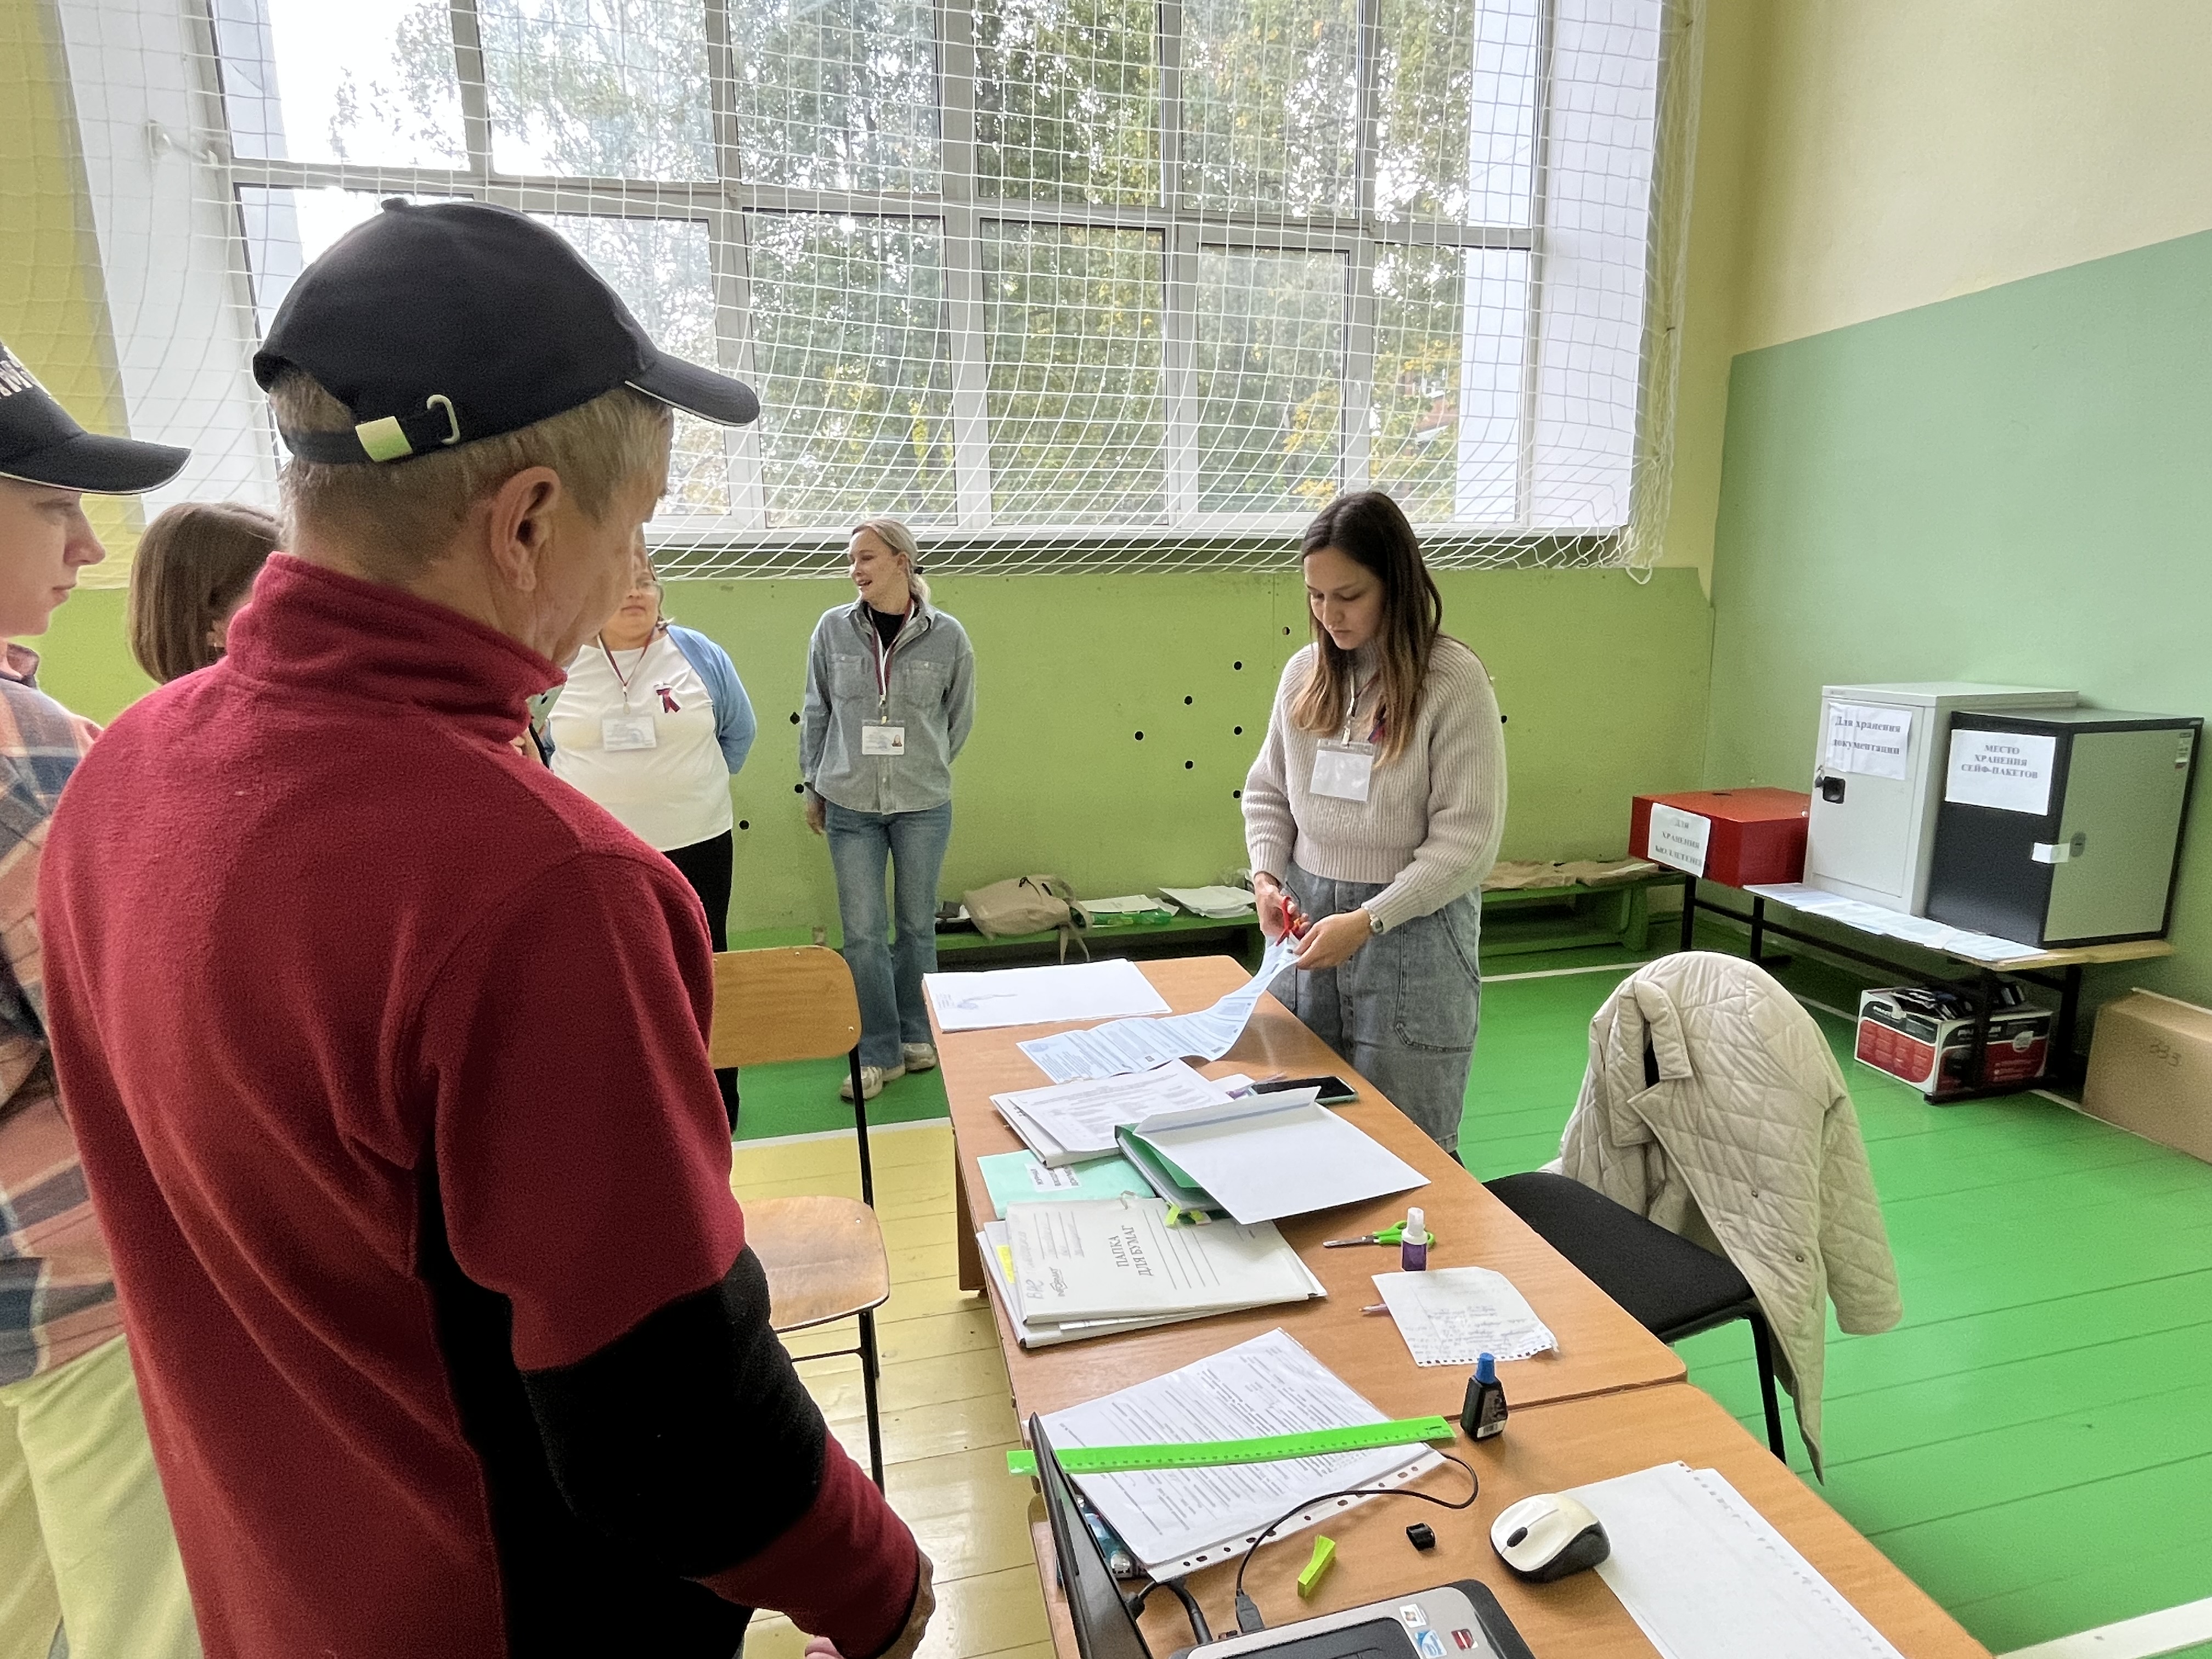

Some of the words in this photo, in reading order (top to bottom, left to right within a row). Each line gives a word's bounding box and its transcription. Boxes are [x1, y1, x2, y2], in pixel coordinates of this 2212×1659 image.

[1835, 716, 1853, 726] Для
[1855, 720, 1901, 732] хранения
[1984, 745, 2020, 754] МЕСТО
[1974, 754, 2028, 766] ХРАНЕНИЯ
[1961, 764, 2038, 778] СЕЙФ-ПАКЕТОВ
[1662, 831, 1700, 849] ХРАНЕНИЯ
[1121, 1225, 1143, 1255] БУМАГ
[1108, 1235, 1130, 1267] ПАПКА
[1133, 1256, 1154, 1276] ДЛЯ
